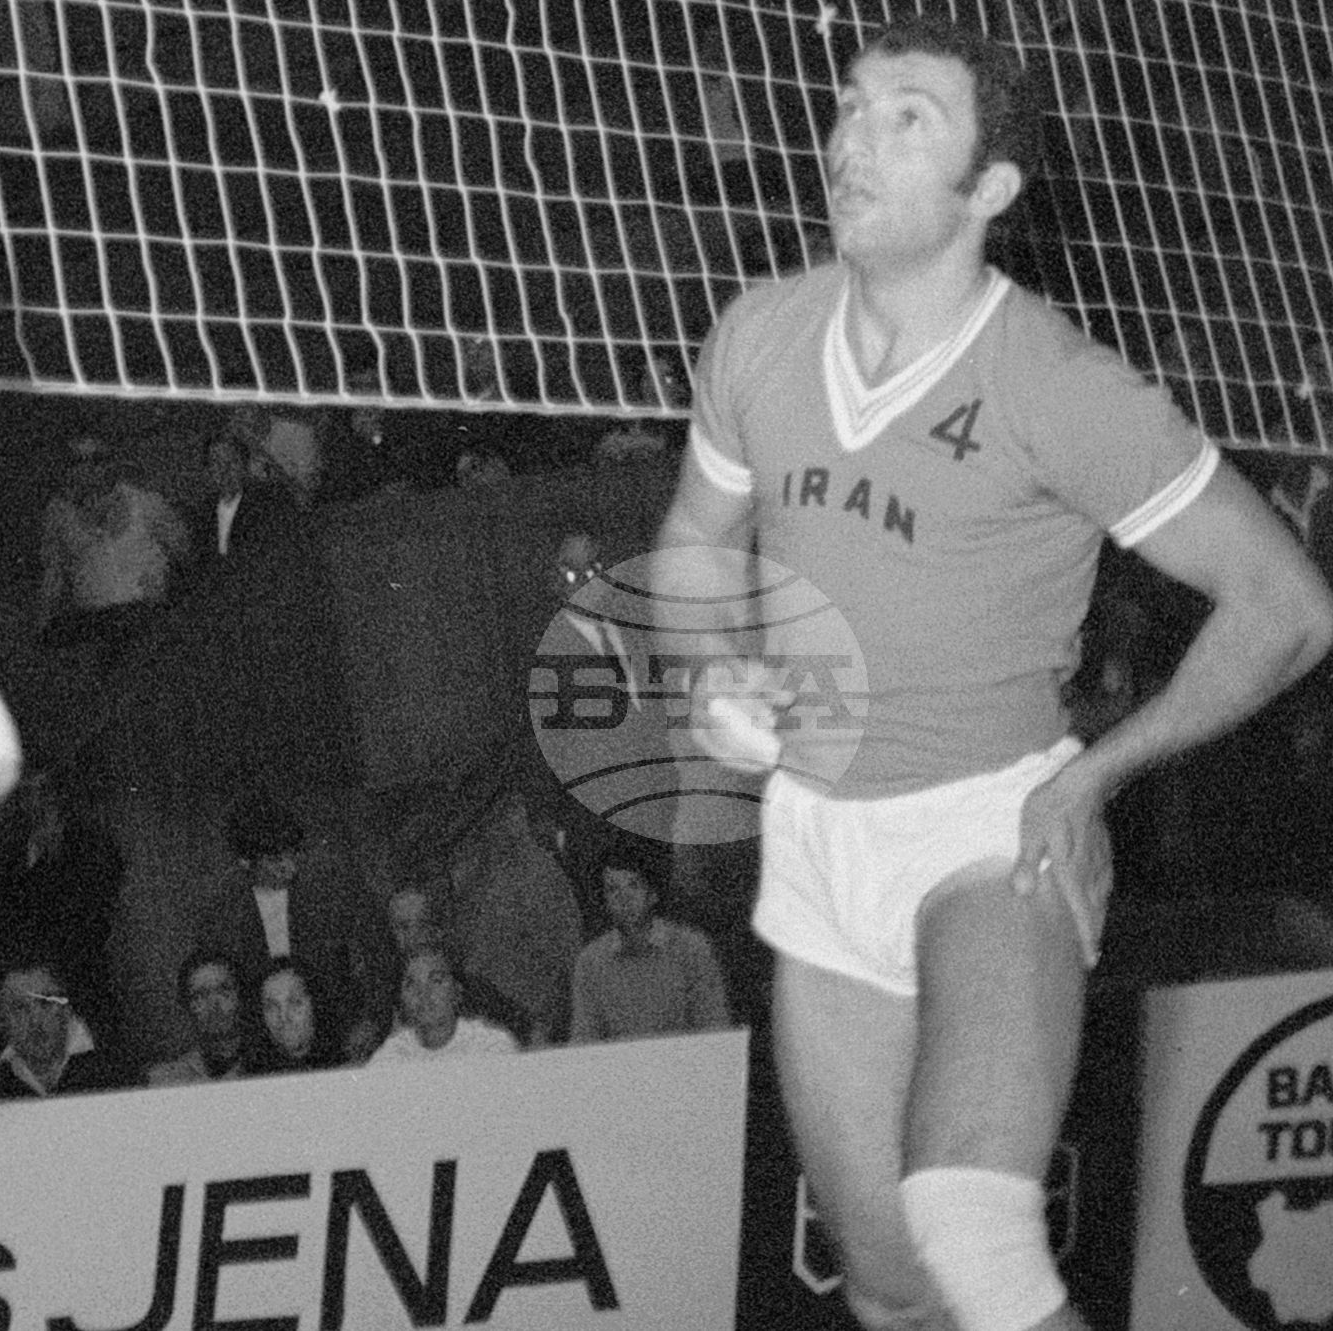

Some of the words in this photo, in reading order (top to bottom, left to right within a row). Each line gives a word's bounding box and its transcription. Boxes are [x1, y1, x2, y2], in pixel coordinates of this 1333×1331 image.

[929, 398, 982, 462] 4
[783, 466, 916, 545] IRAN
[1258, 1119, 1333, 1162] TO
[44, 1148, 621, 1331] JENA
